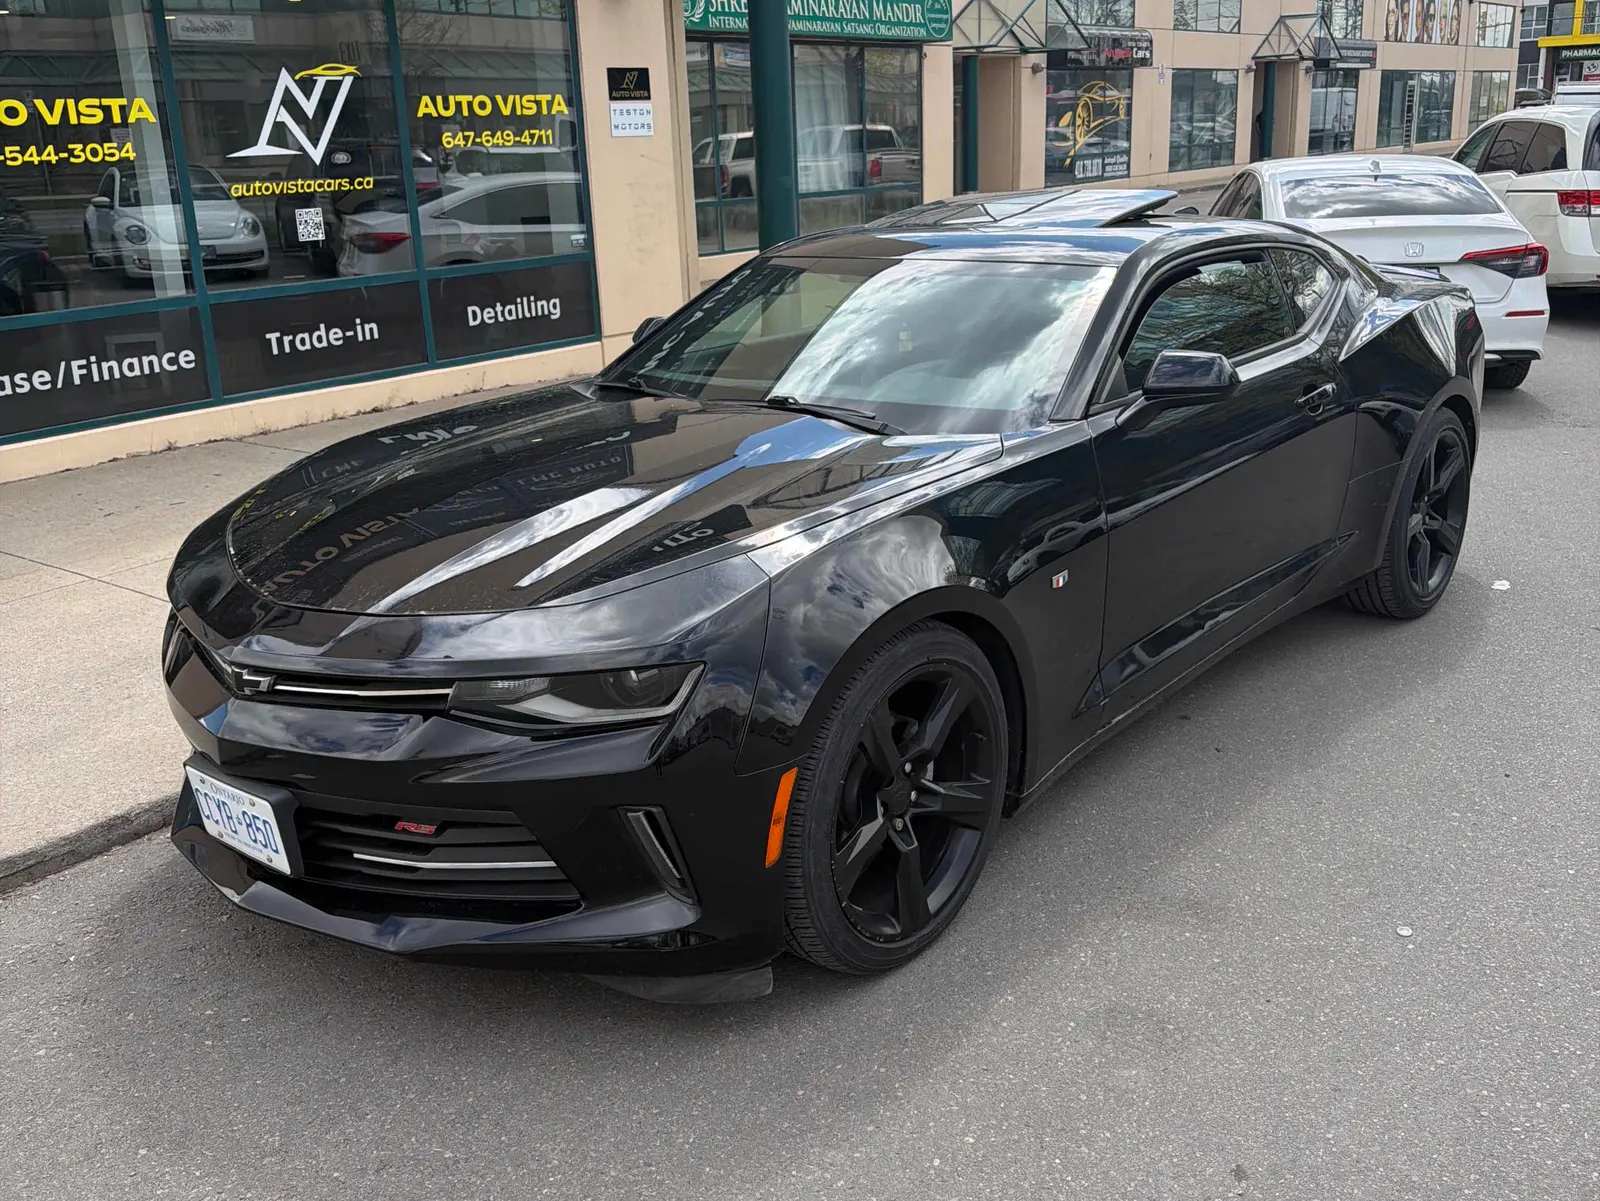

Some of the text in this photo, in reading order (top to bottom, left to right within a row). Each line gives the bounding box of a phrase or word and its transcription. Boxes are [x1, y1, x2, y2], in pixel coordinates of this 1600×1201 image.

[872, 0, 925, 23] MANDIR
[708, 14, 927, 38] INTERNA AMINARAYAN SATSANG ORGANIZATION
[416, 93, 569, 118] AUTO VISTA
[630, 90, 649, 98] VISTA
[33, 97, 157, 125] VISTA
[612, 108, 652, 116] TESTON
[613, 122, 652, 131] MOTORS
[441, 129, 553, 148] 647-649-4711
[230, 176, 374, 198] autovistacars.ca
[467, 296, 561, 328] Detailing
[265, 318, 379, 356] Trade-in
[210, 782, 245, 806] ONTARIO
[194, 787, 280, 854] CCYB 850
[394, 821, 437, 835] RS
